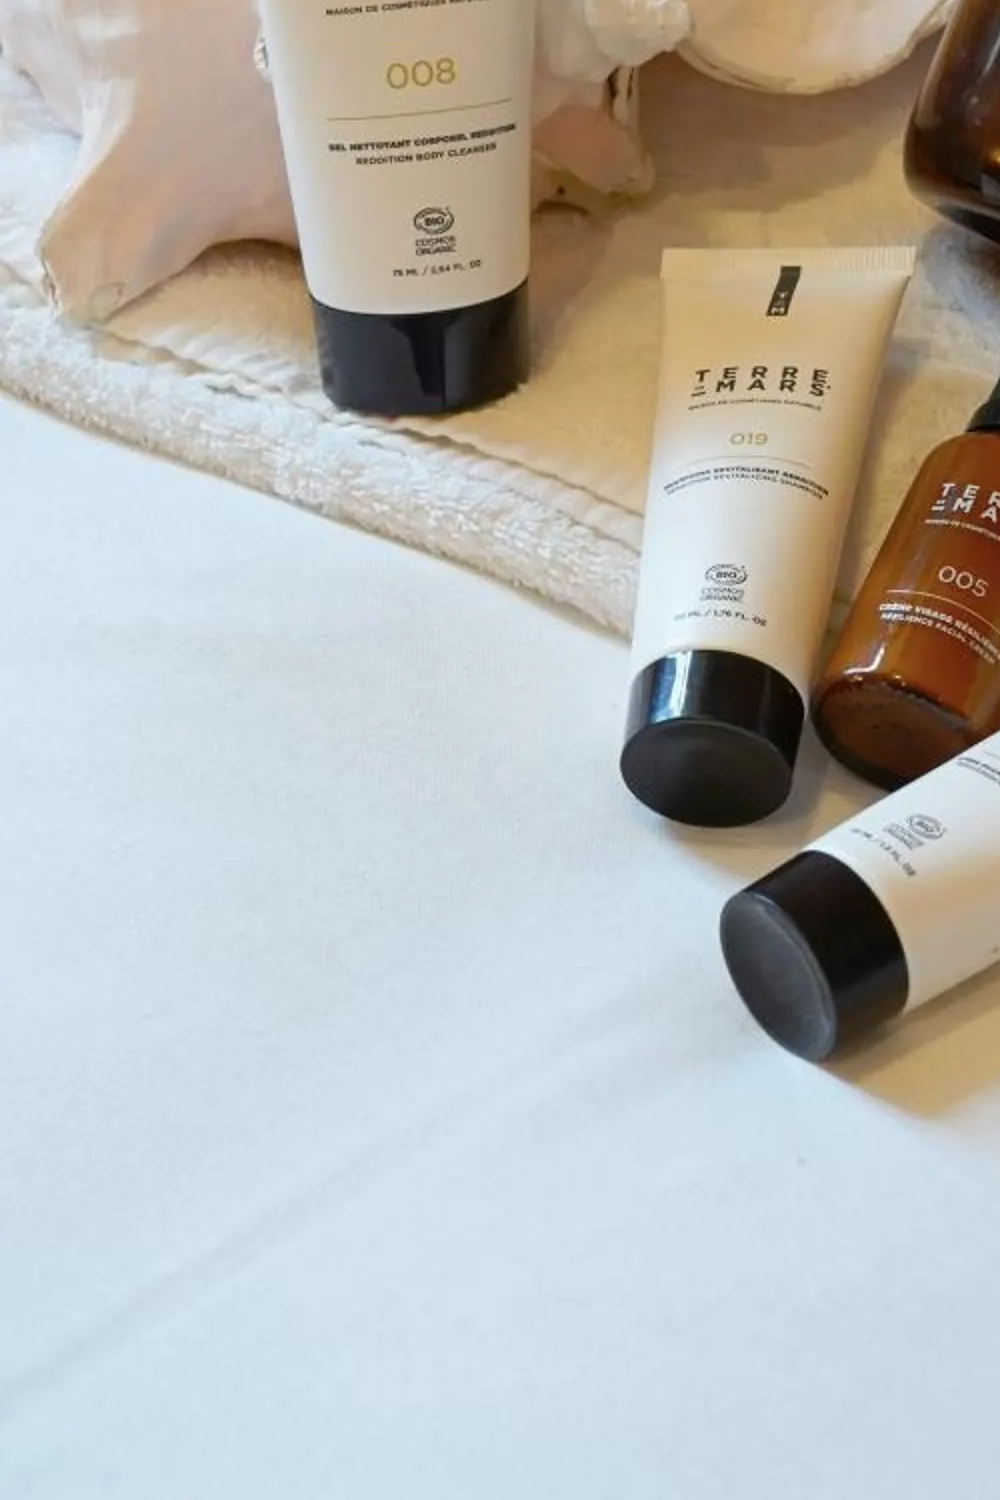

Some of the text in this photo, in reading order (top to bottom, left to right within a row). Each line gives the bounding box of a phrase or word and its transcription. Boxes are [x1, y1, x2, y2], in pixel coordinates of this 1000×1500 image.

[365, 4, 379, 14] DE
[385, 56, 457, 90] 008
[349, 139, 412, 151] NETTOYANT
[415, 151, 444, 162] BODY
[695, 365, 829, 384] TERRE
[715, 380, 825, 397] MARS
[729, 432, 768, 445] 019
[938, 565, 990, 597] 005
